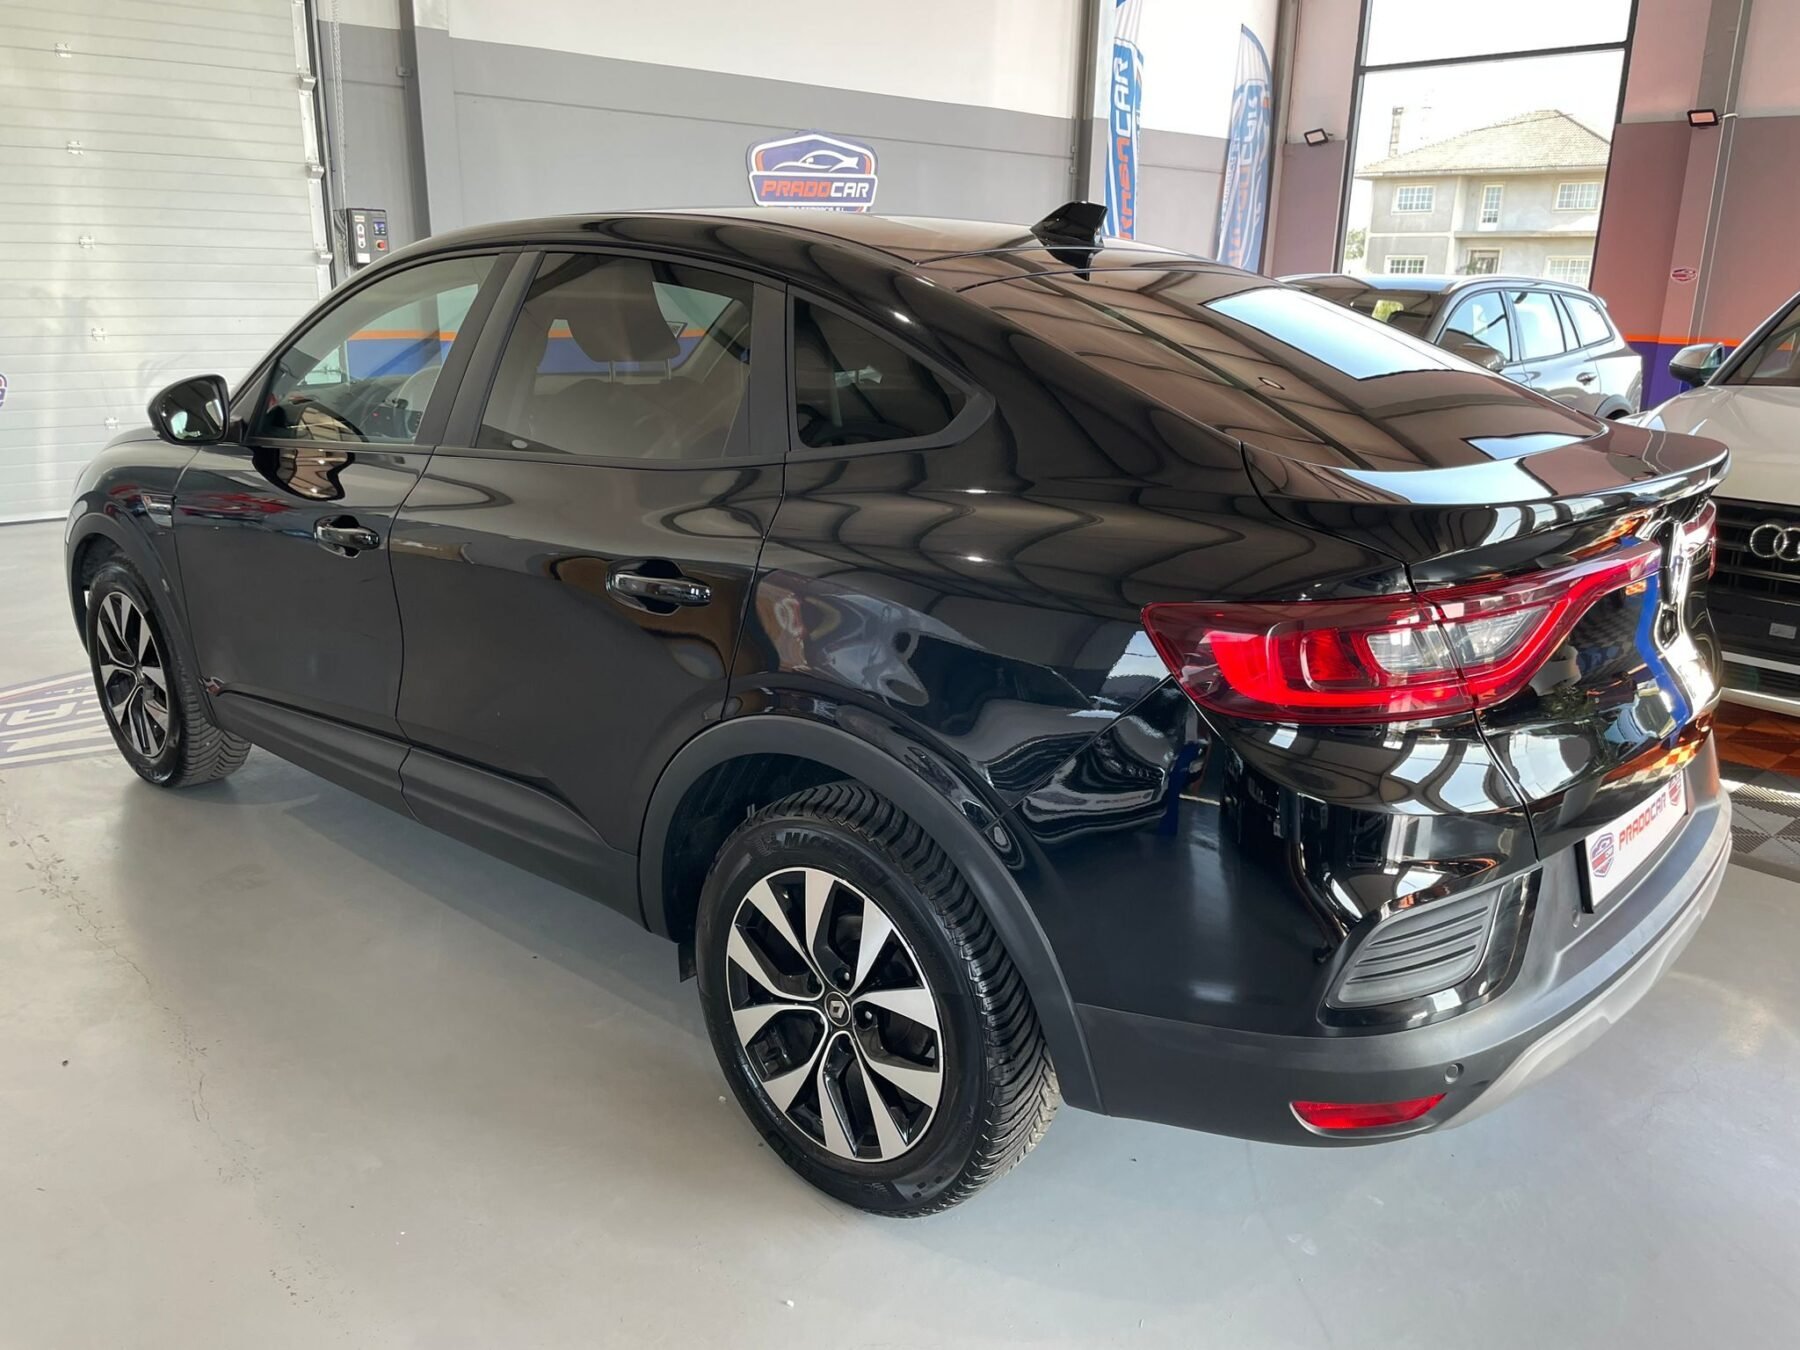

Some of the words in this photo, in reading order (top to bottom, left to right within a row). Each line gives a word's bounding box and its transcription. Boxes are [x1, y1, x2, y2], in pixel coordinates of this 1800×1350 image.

[1113, 57, 1133, 240] RADOCAR
[761, 179, 869, 198] PRADOCAR
[1618, 791, 1667, 851] PRADOCAR
